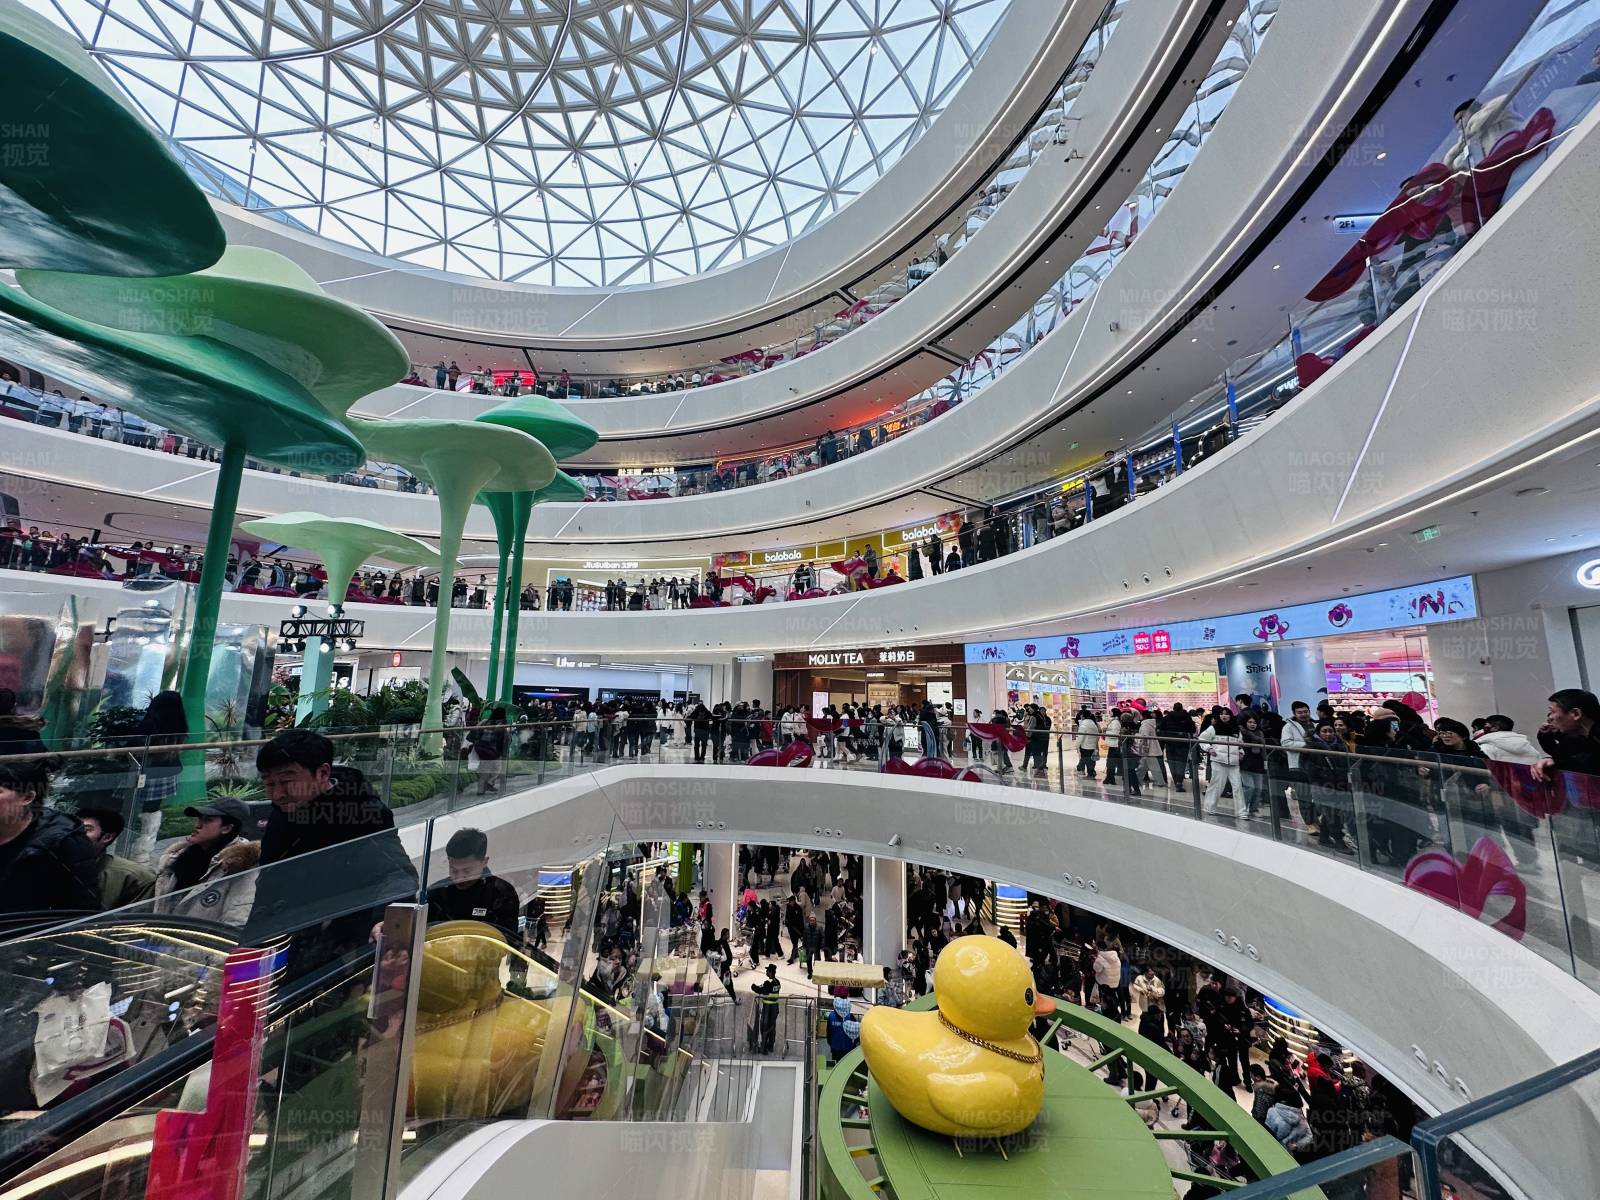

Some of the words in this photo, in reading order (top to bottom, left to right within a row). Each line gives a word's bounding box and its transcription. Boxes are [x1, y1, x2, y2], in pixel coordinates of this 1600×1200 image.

[765, 550, 801, 562] balabala
[809, 654, 841, 665] MOLLY
[843, 653, 864, 664] TEA
